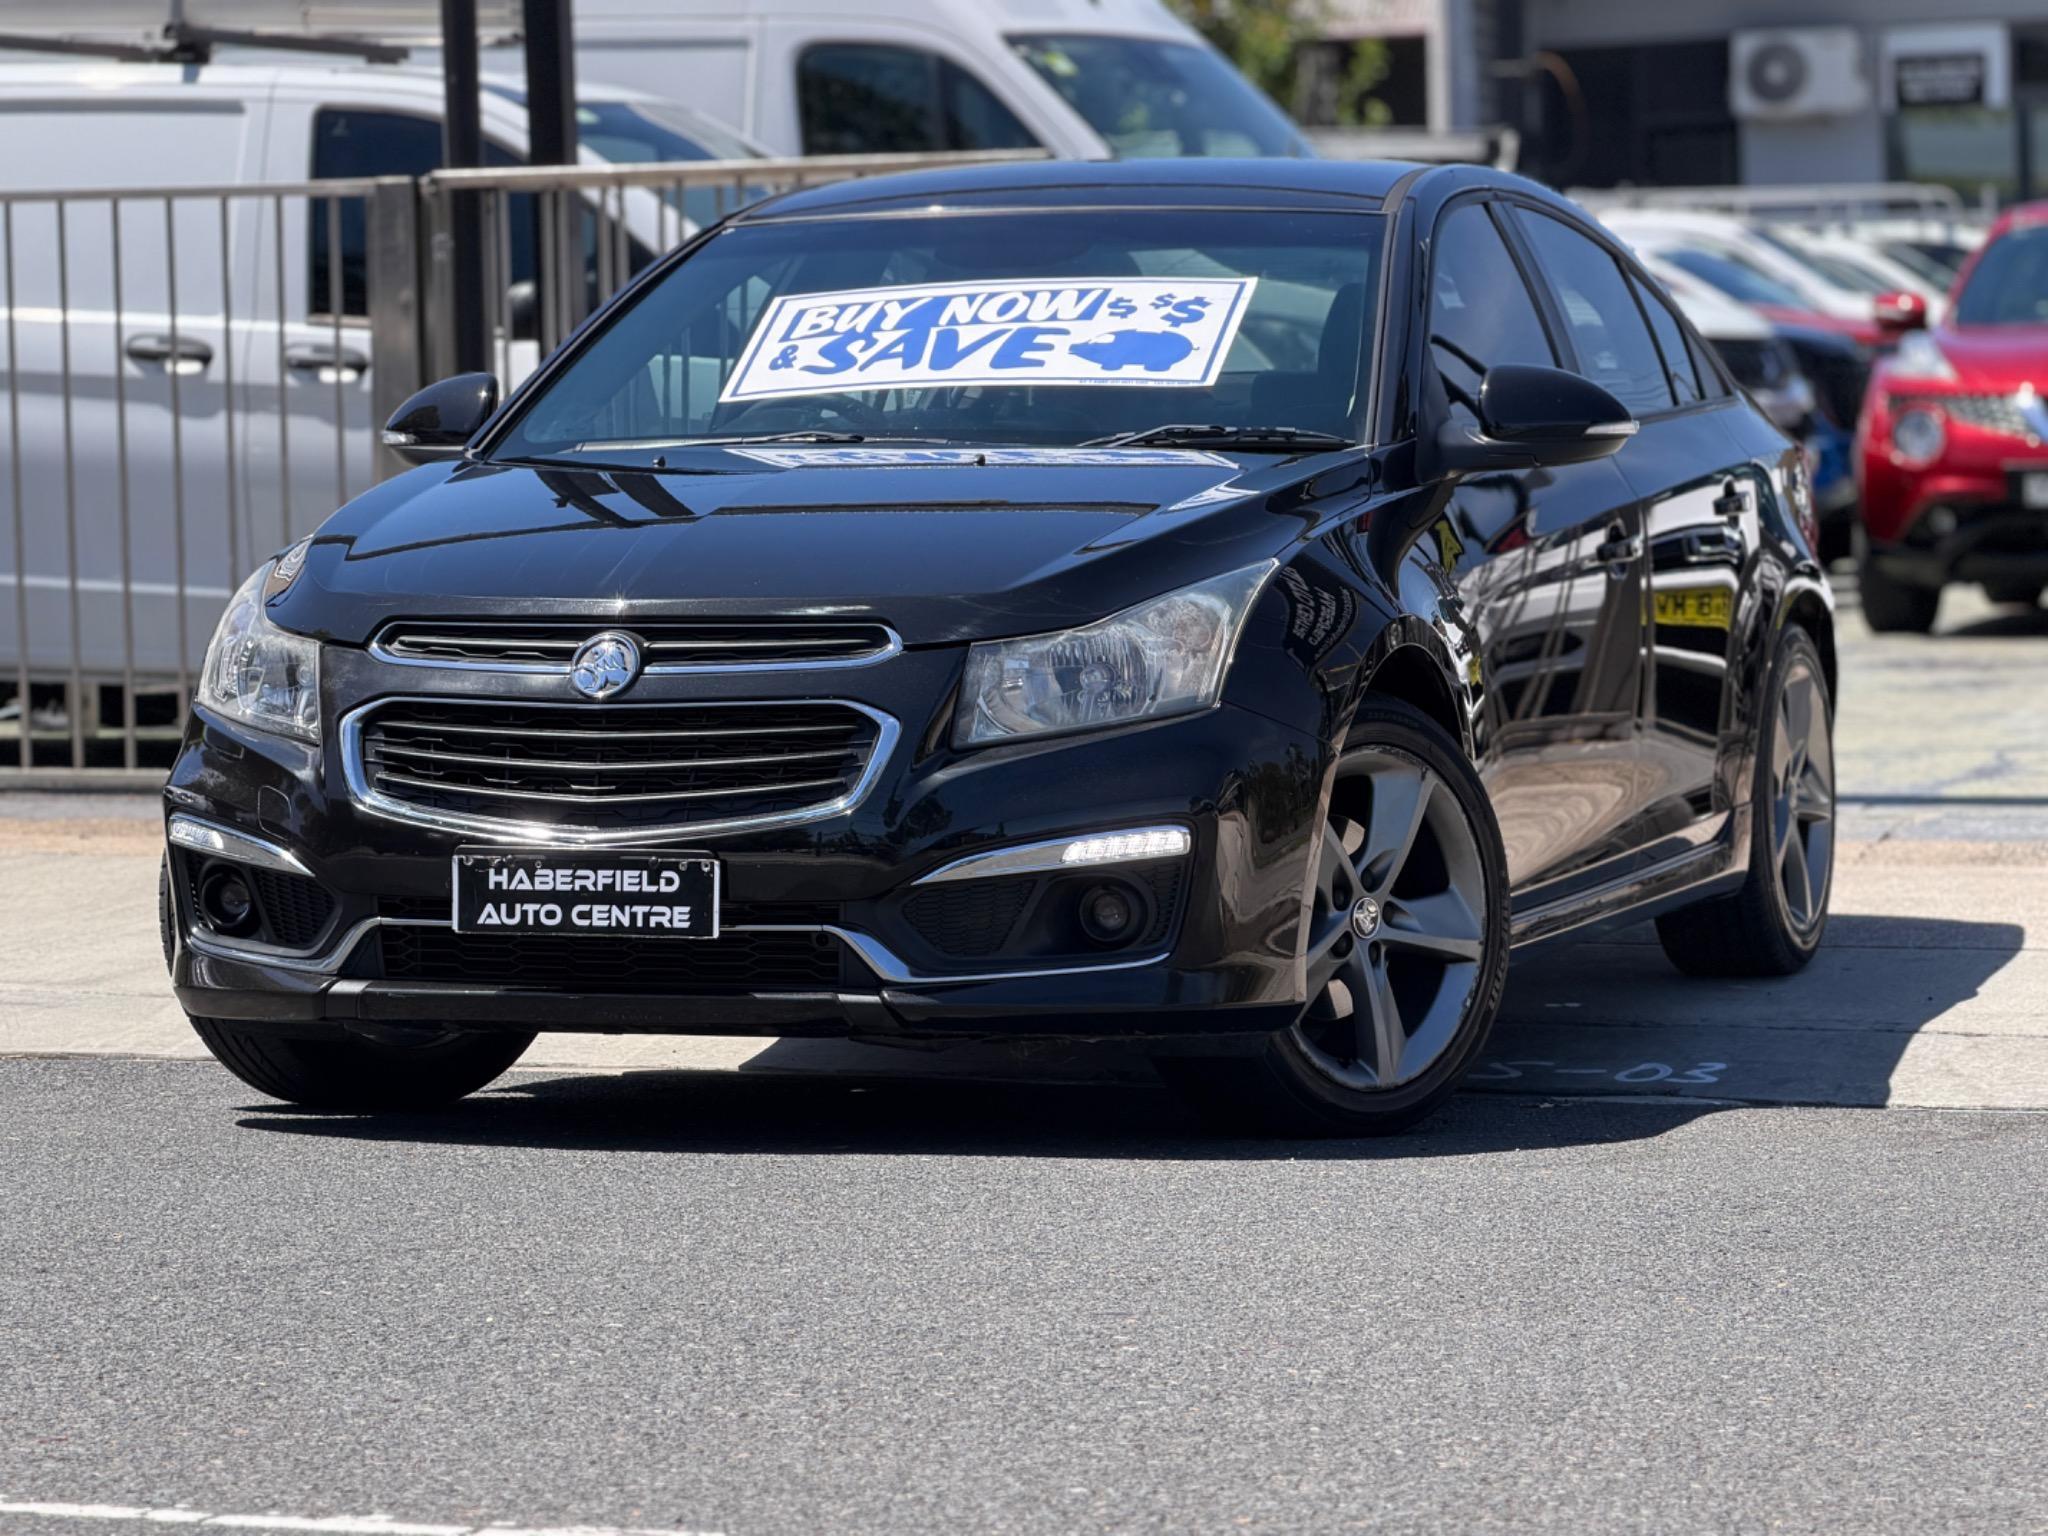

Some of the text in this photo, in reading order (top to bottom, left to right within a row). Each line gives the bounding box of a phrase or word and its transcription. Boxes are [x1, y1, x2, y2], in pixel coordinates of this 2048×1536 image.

[790, 290, 1103, 340] BUY NOW
[770, 326, 1071, 375] & SAVE
[488, 867, 681, 893] HABERFIELD
[476, 902, 692, 929] AUTO CENTRE
